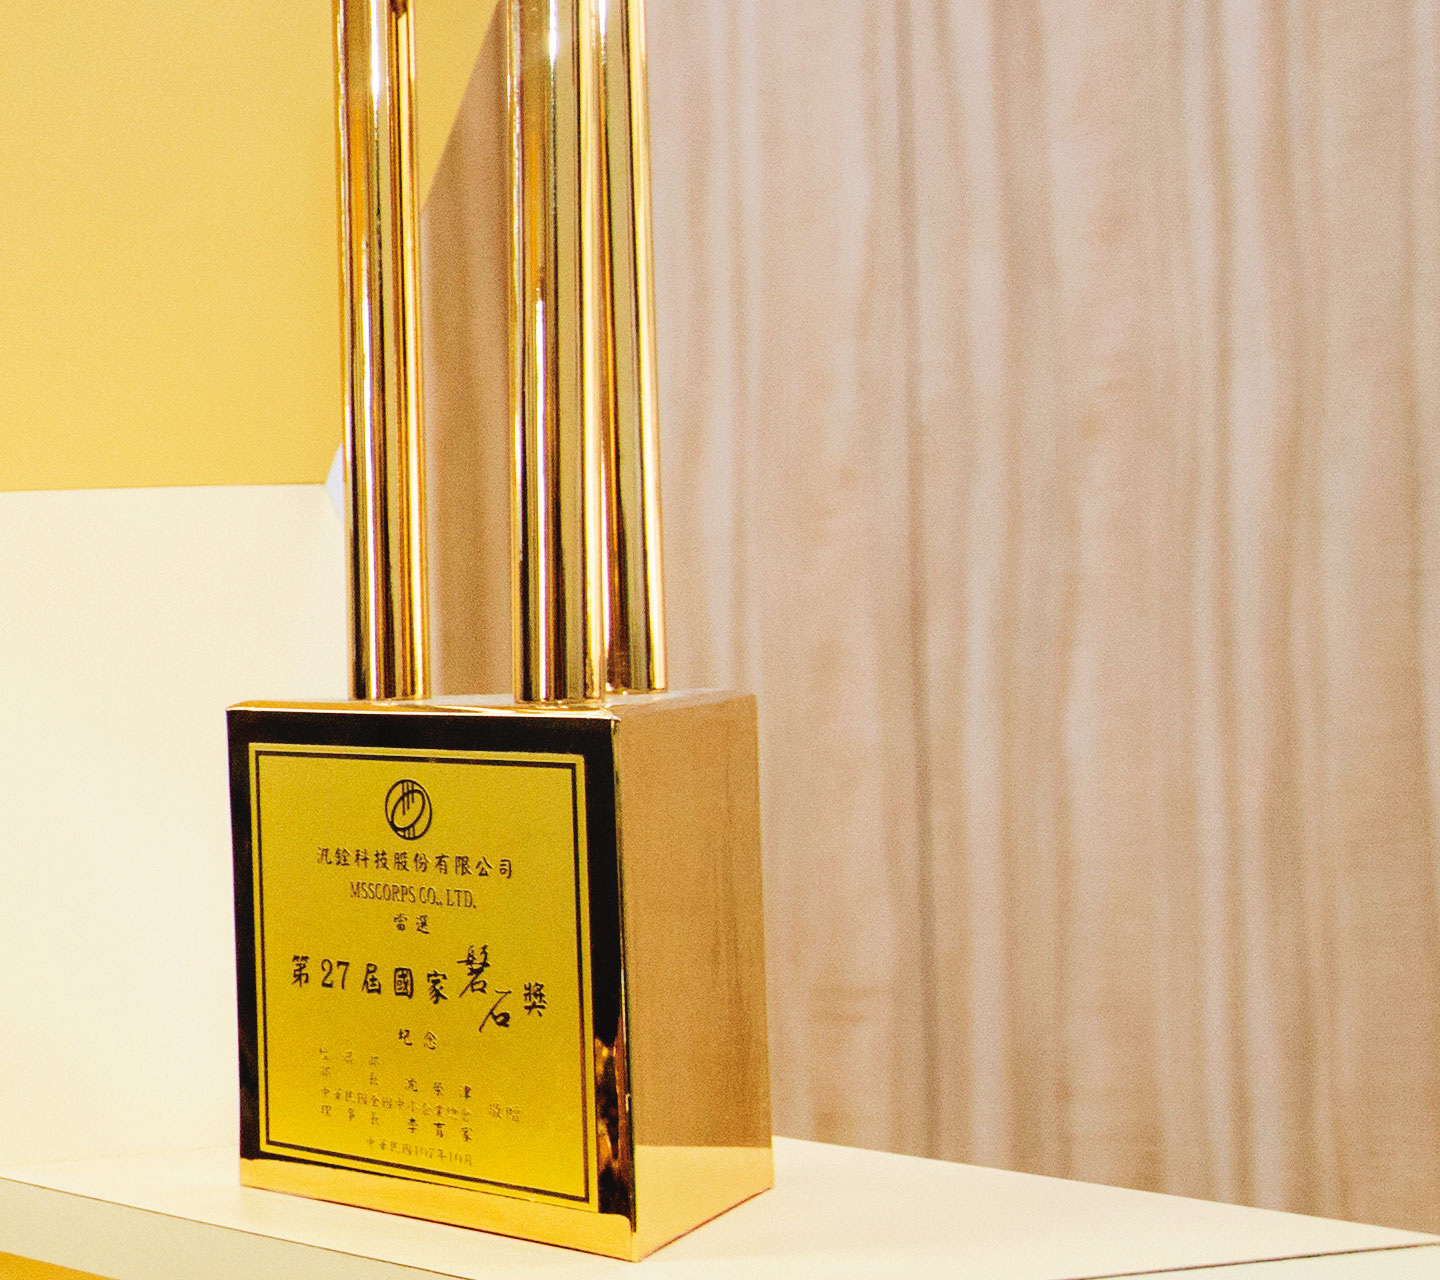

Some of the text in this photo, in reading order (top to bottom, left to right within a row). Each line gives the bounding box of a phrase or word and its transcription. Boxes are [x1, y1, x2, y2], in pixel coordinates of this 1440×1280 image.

[317, 846, 513, 879] 汎銓科技股份有限公司
[350, 881, 416, 903] MSSCORPS
[446, 888, 477, 909] LTD.
